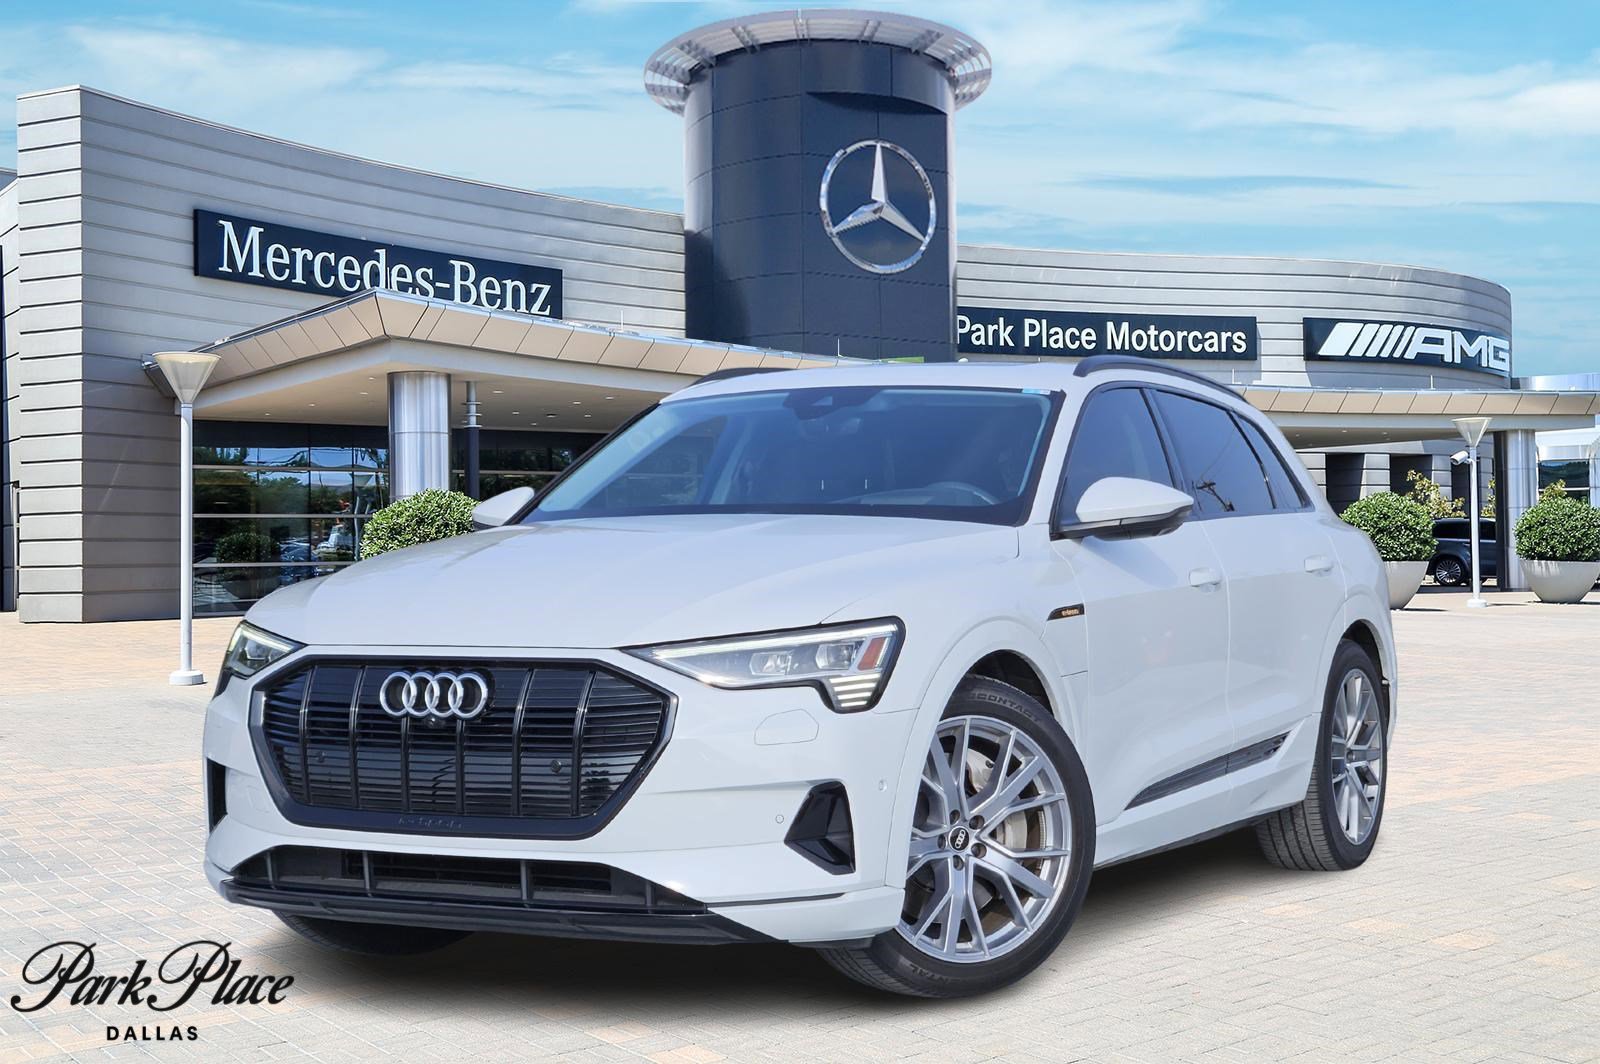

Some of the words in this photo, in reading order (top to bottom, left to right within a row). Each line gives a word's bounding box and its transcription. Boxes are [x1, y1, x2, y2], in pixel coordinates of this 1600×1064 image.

[217, 219, 552, 316] Mercedes-Benz
[956, 314, 1014, 347] Park
[1023, 318, 1097, 350] Place
[1106, 320, 1248, 353] Motorcars
